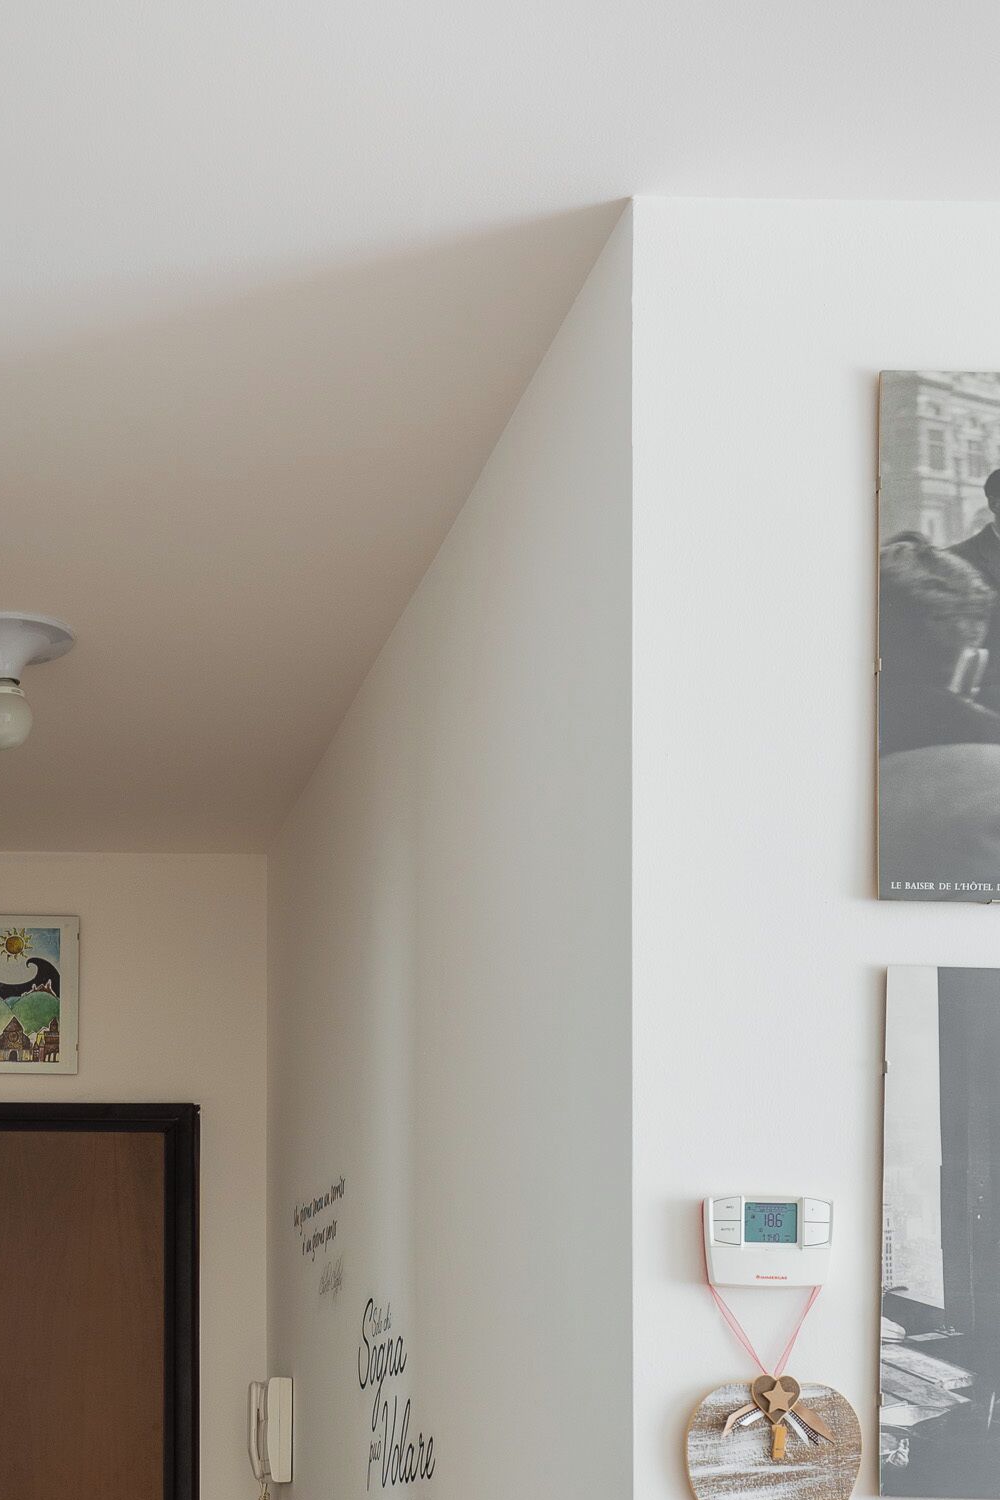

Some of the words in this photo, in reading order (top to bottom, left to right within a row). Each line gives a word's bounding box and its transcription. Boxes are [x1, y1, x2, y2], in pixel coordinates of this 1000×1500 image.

[890, 881, 902, 890] LE
[904, 881, 935, 890] BAISER
[938, 882, 952, 891] DE
[954, 880, 994, 891] L'HÔTEL
[357, 1297, 408, 1432] Sogna
[381, 1394, 436, 1489] Volare
